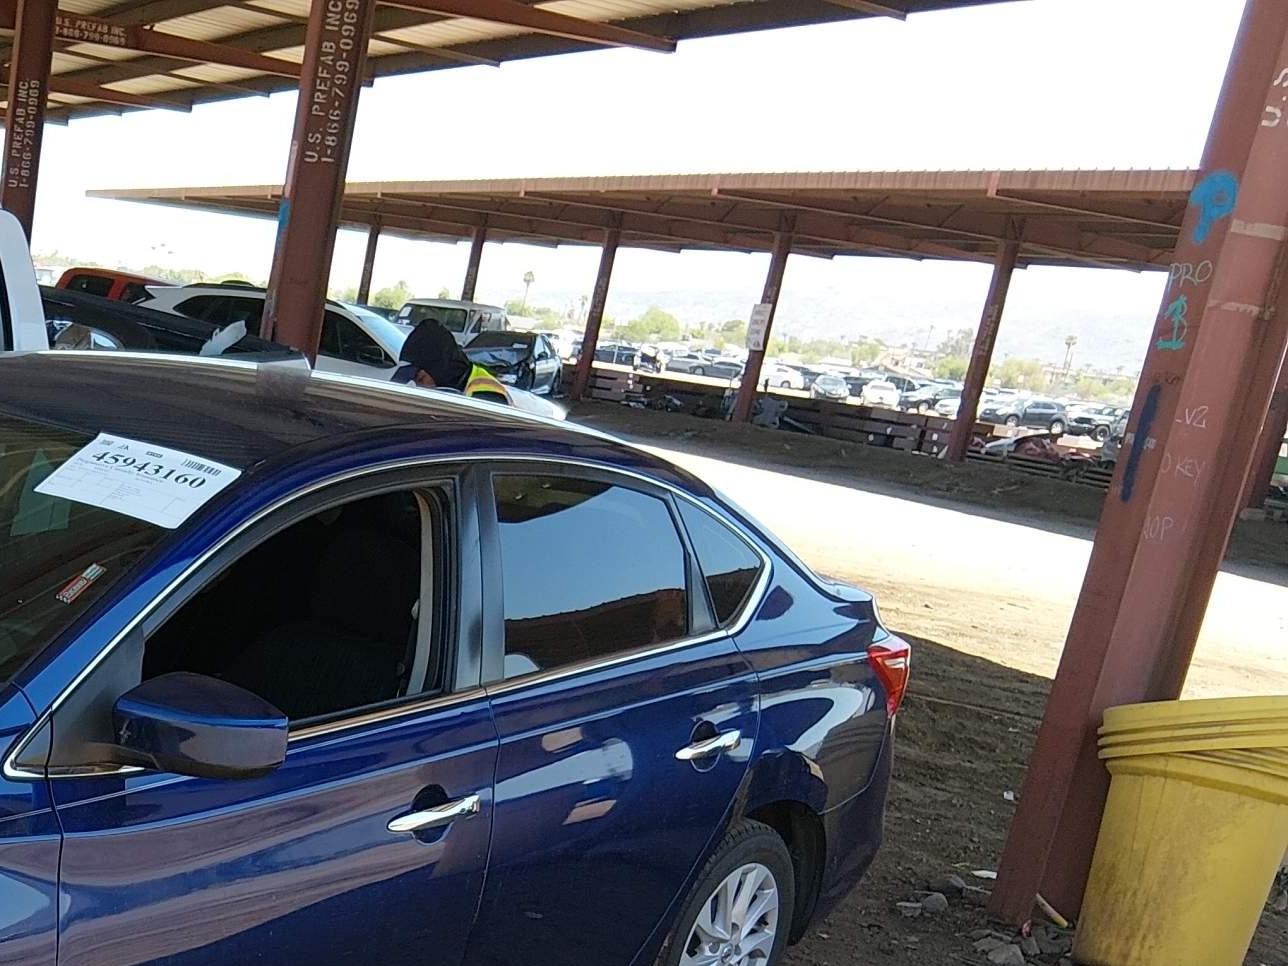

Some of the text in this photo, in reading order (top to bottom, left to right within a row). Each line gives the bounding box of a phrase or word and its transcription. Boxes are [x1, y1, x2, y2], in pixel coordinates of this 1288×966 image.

[312, 41, 337, 117] PREFAB
[11, 107, 27, 158] PREFAB
[304, 127, 323, 163] U.S.
[1168, 260, 1213, 289] PRO
[92, 451, 206, 489] 45943160
